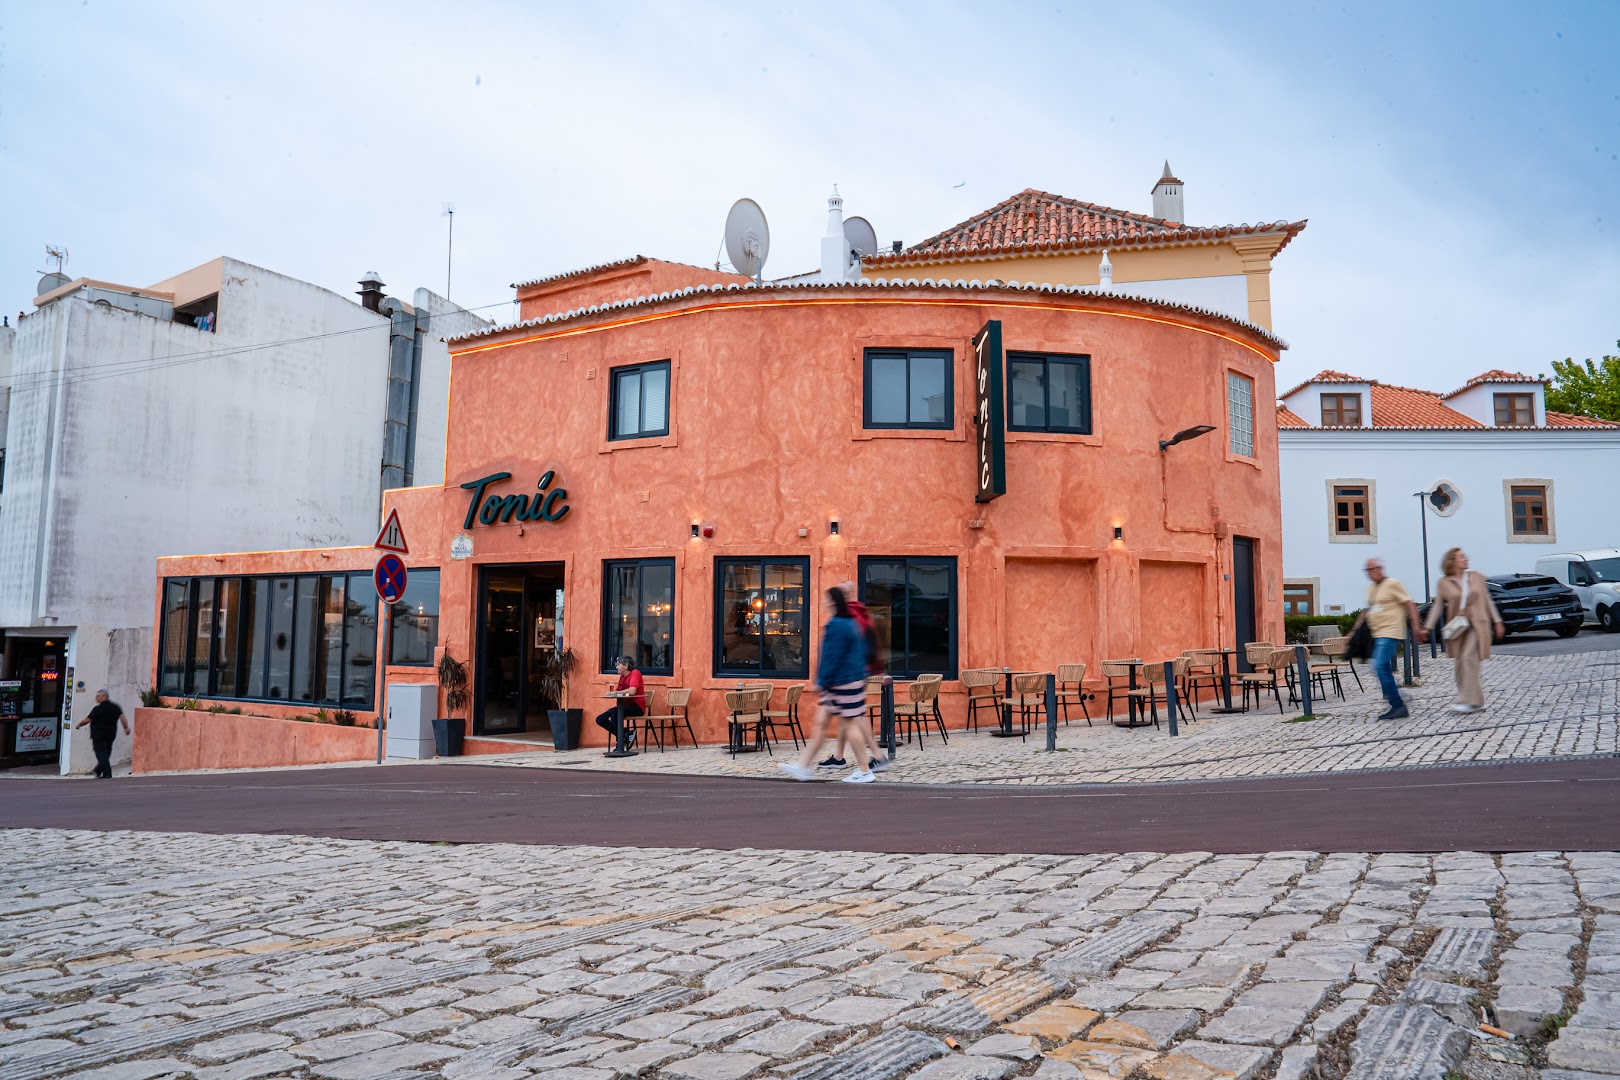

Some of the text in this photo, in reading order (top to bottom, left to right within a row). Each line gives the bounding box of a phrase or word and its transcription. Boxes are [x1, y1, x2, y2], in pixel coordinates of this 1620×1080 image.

[976, 330, 990, 490] Tonic
[460, 470, 570, 530] Tonic
[20, 724, 53, 741] Eddys
